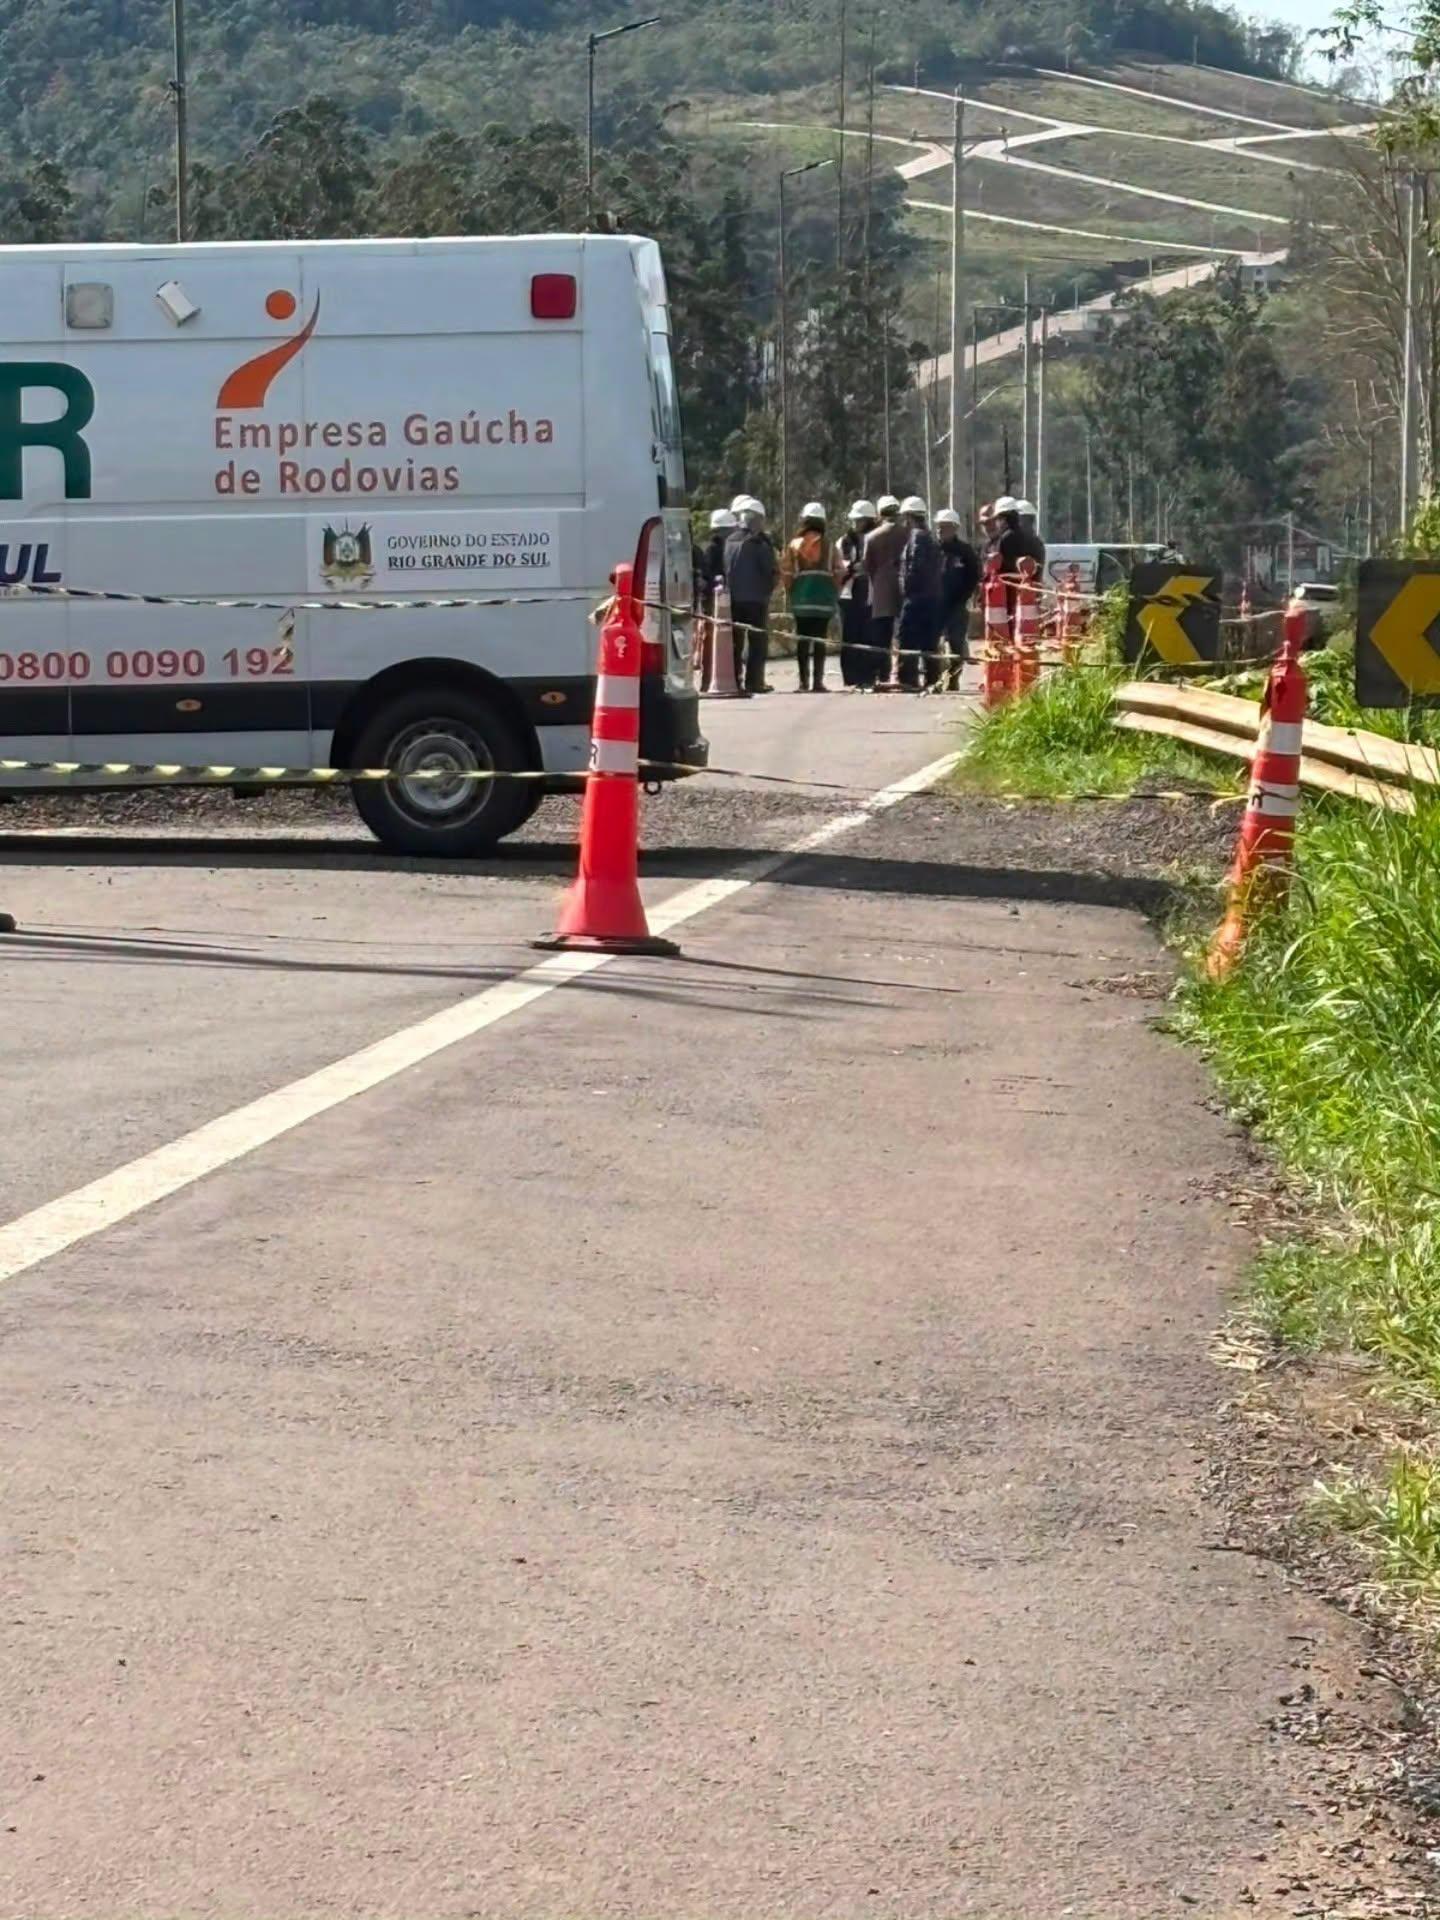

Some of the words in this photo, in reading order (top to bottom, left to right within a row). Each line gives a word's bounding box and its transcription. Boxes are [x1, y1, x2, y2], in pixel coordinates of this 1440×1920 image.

[214, 416, 387, 455] Empresa
[403, 409, 554, 447] Gaúcha
[214, 460, 261, 495] de
[279, 457, 460, 494] Rodovias
[387, 534, 461, 549] GOVERNO
[465, 533, 487, 548] DO
[491, 532, 550, 547] ESTADO
[388, 554, 416, 569] RIO
[421, 553, 488, 569] GRANDE
[493, 552, 517, 567] DO
[520, 551, 551, 567] SUL
[106, 648, 206, 679] 0090
[222, 646, 294, 676] 192
